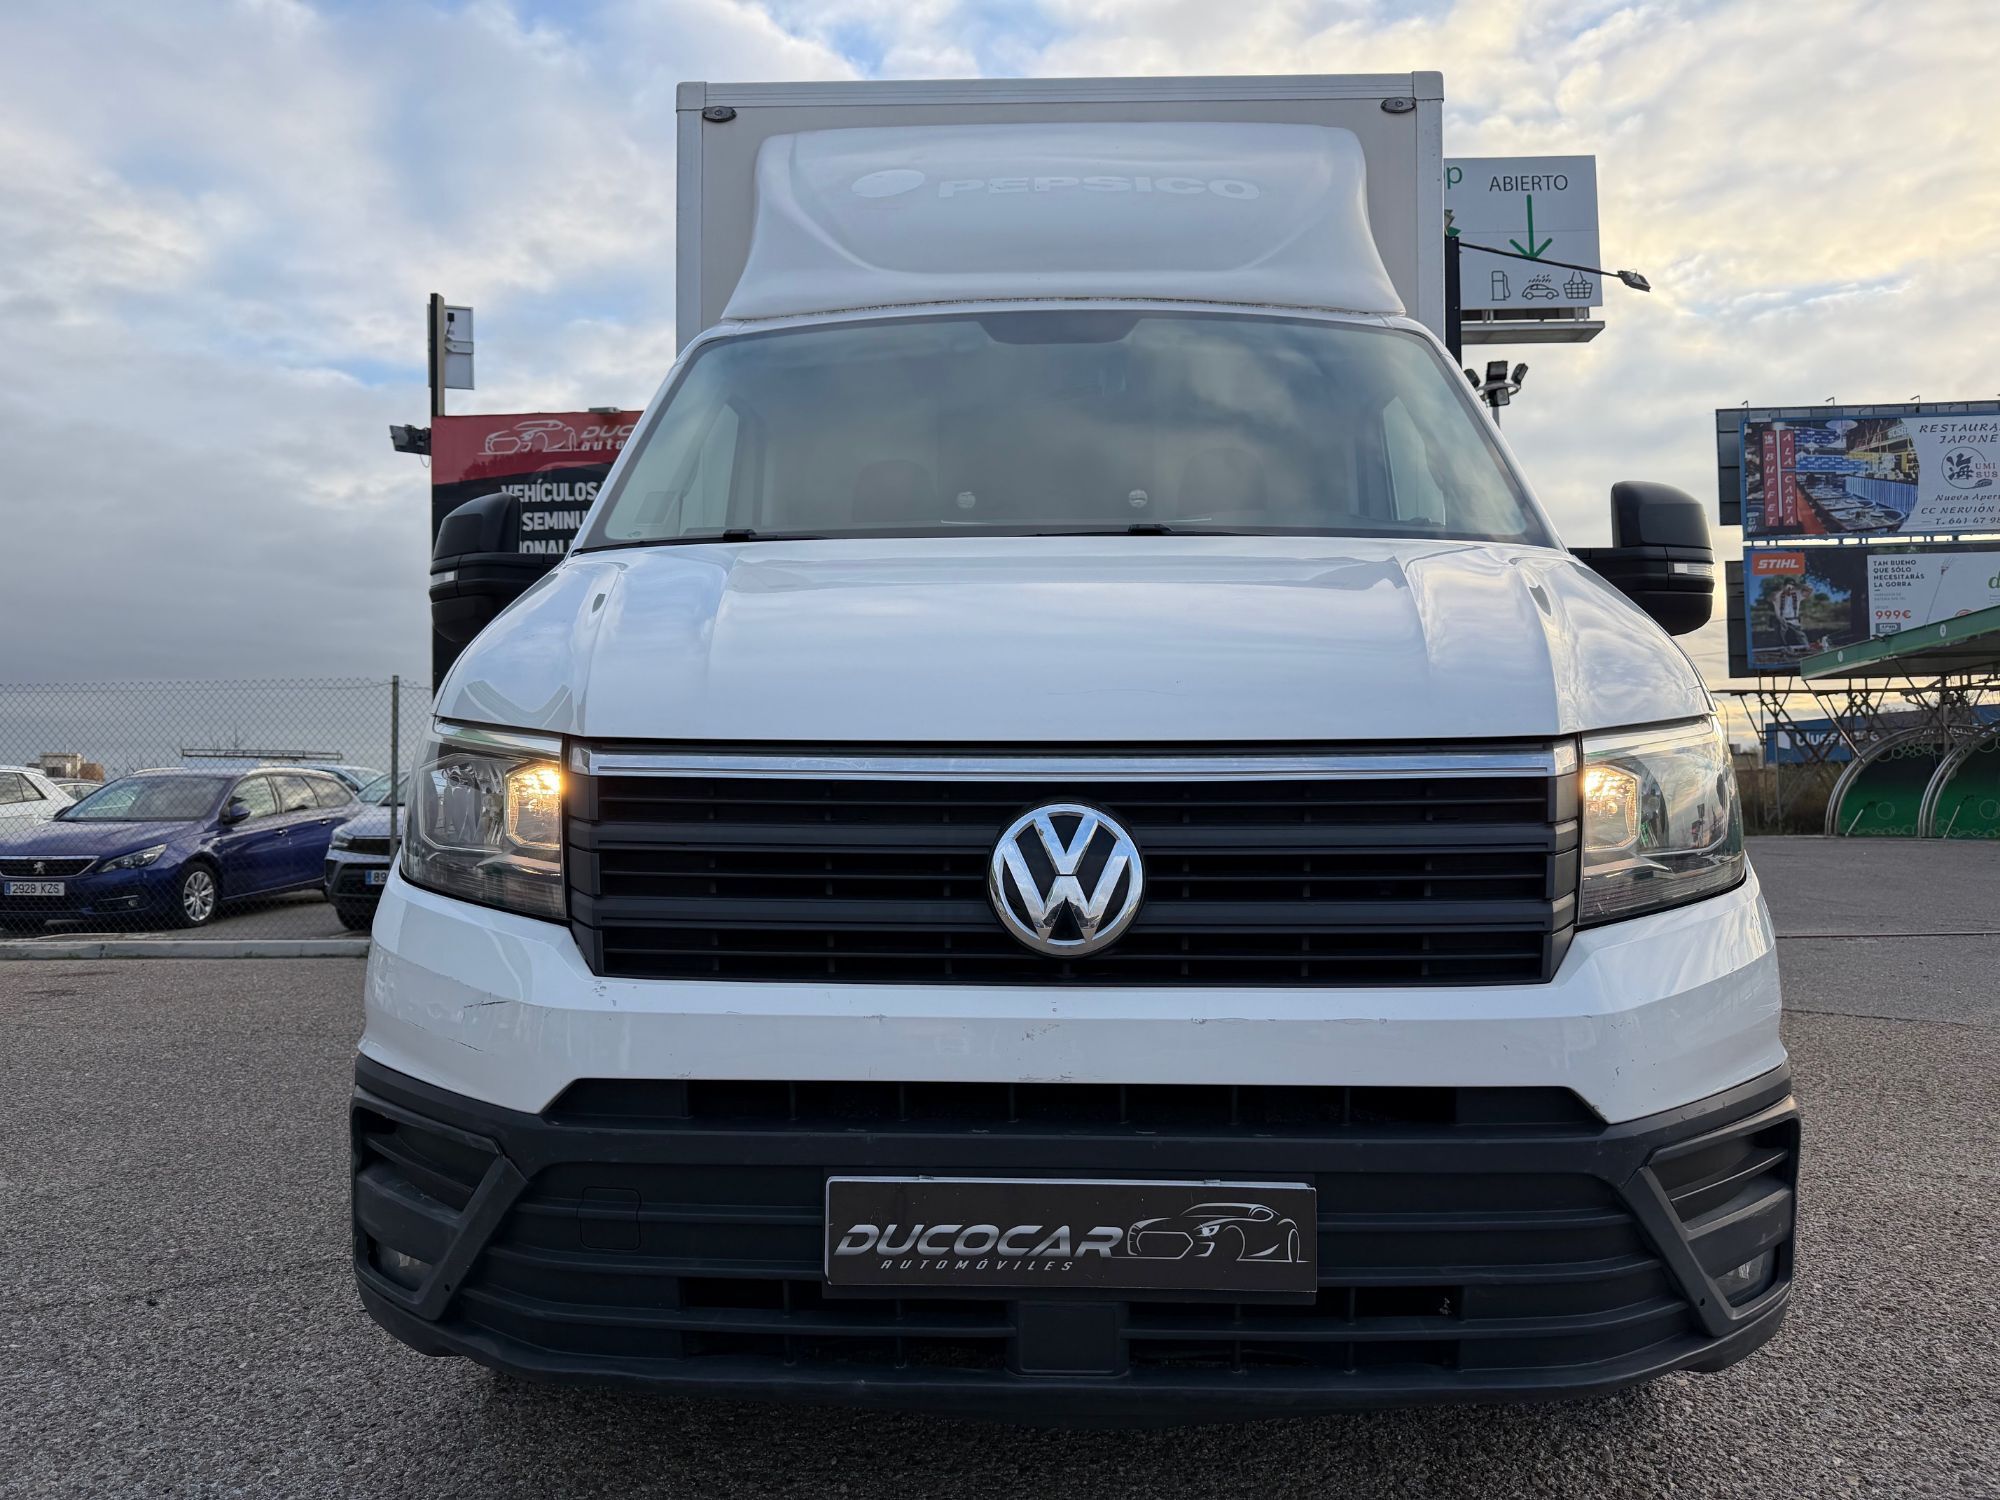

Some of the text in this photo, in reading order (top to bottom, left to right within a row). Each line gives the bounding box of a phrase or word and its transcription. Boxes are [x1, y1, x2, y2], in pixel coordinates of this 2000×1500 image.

[938, 176, 1260, 199] PEPSICO
[1489, 174, 1568, 192] ABIERTO
[1919, 423, 2000, 433] RESTAURA
[1975, 462, 1996, 470] UMI
[1765, 453, 1776, 525] BUFFET
[1940, 503, 1994, 514] NERVIÓN
[1758, 559, 1799, 569] STIHL
[1873, 572, 1925, 580] NECESITARÁS
[1875, 609, 1912, 619] 999€
[12, 884, 59, 894] 2928 KZS
[834, 1224, 1125, 1258] DUCOCAR
[880, 1258, 1074, 1272] AUTOMÓVILES
